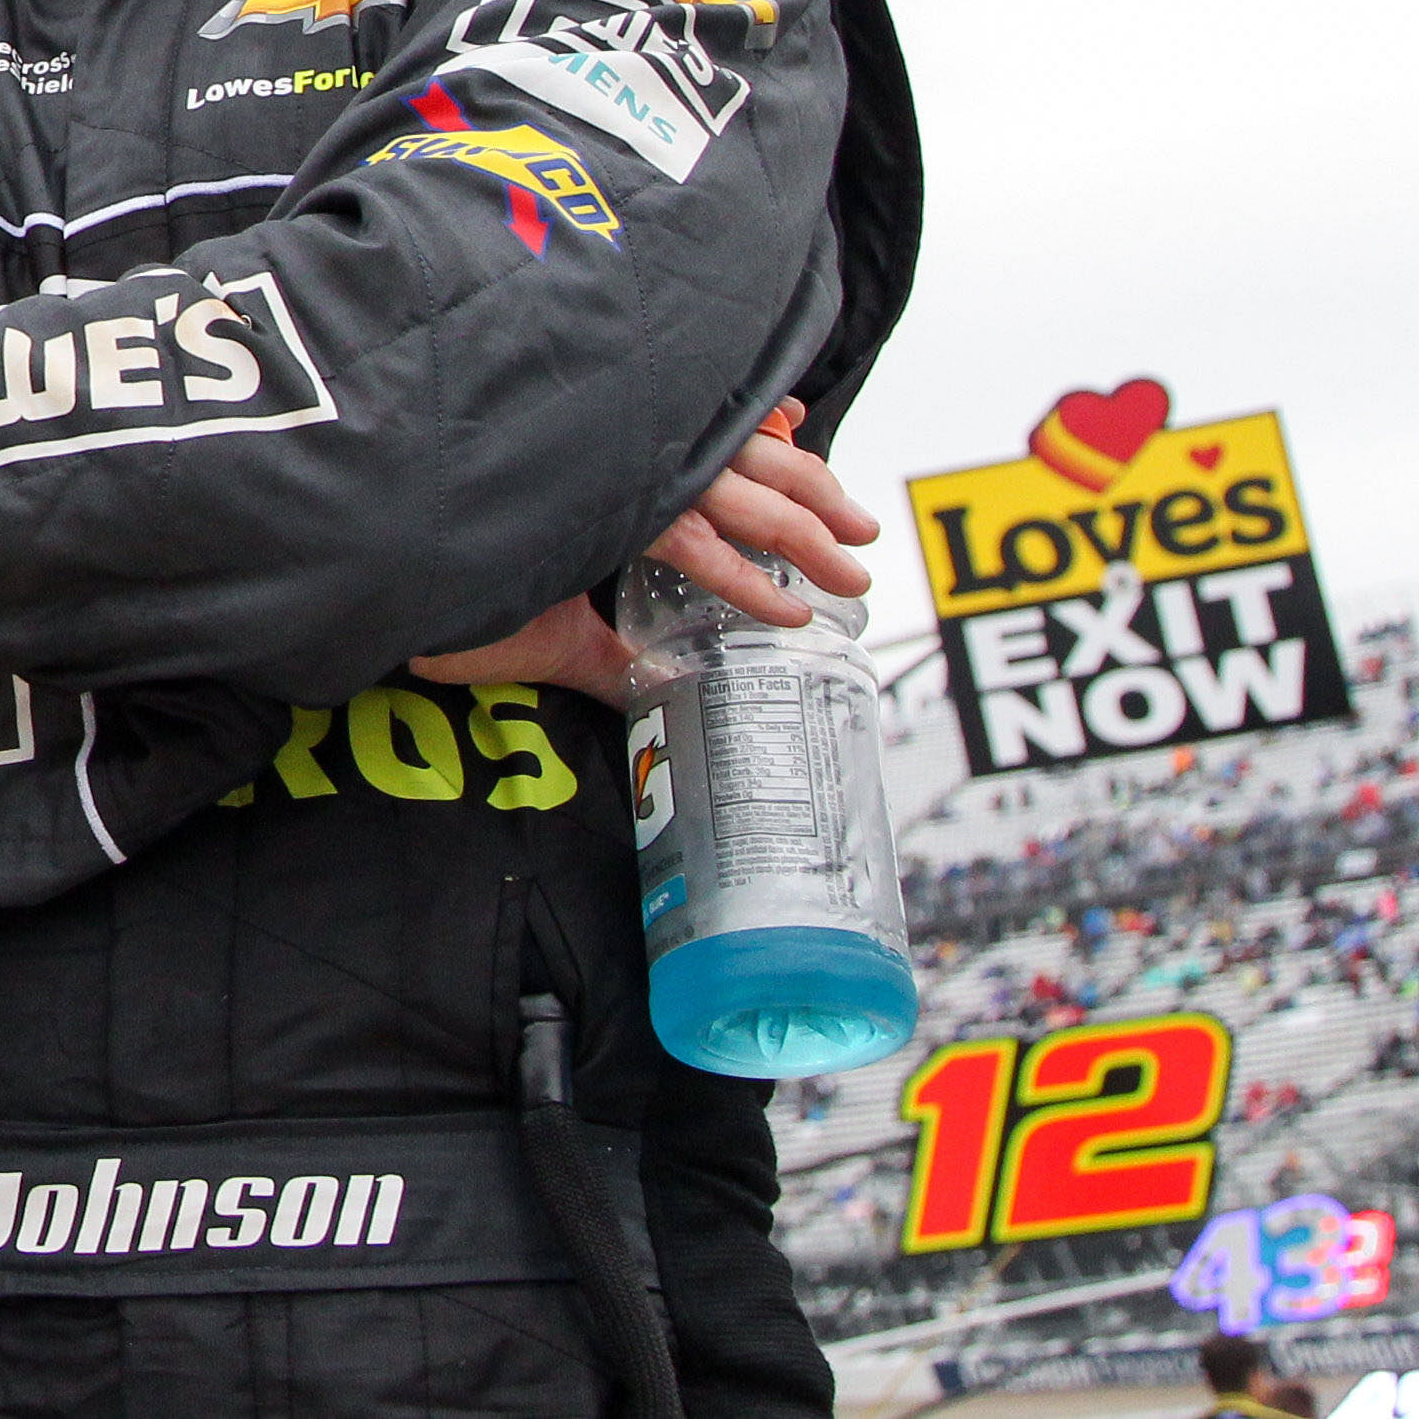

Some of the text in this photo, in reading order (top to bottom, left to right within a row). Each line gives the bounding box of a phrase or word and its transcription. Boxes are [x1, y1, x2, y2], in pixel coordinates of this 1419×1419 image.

[702, 678, 792, 696] Nutrition Facts
[965, 562, 1294, 692] EXIT
[977, 635, 1308, 771] NOW
[901, 1012, 1234, 1256] 12
